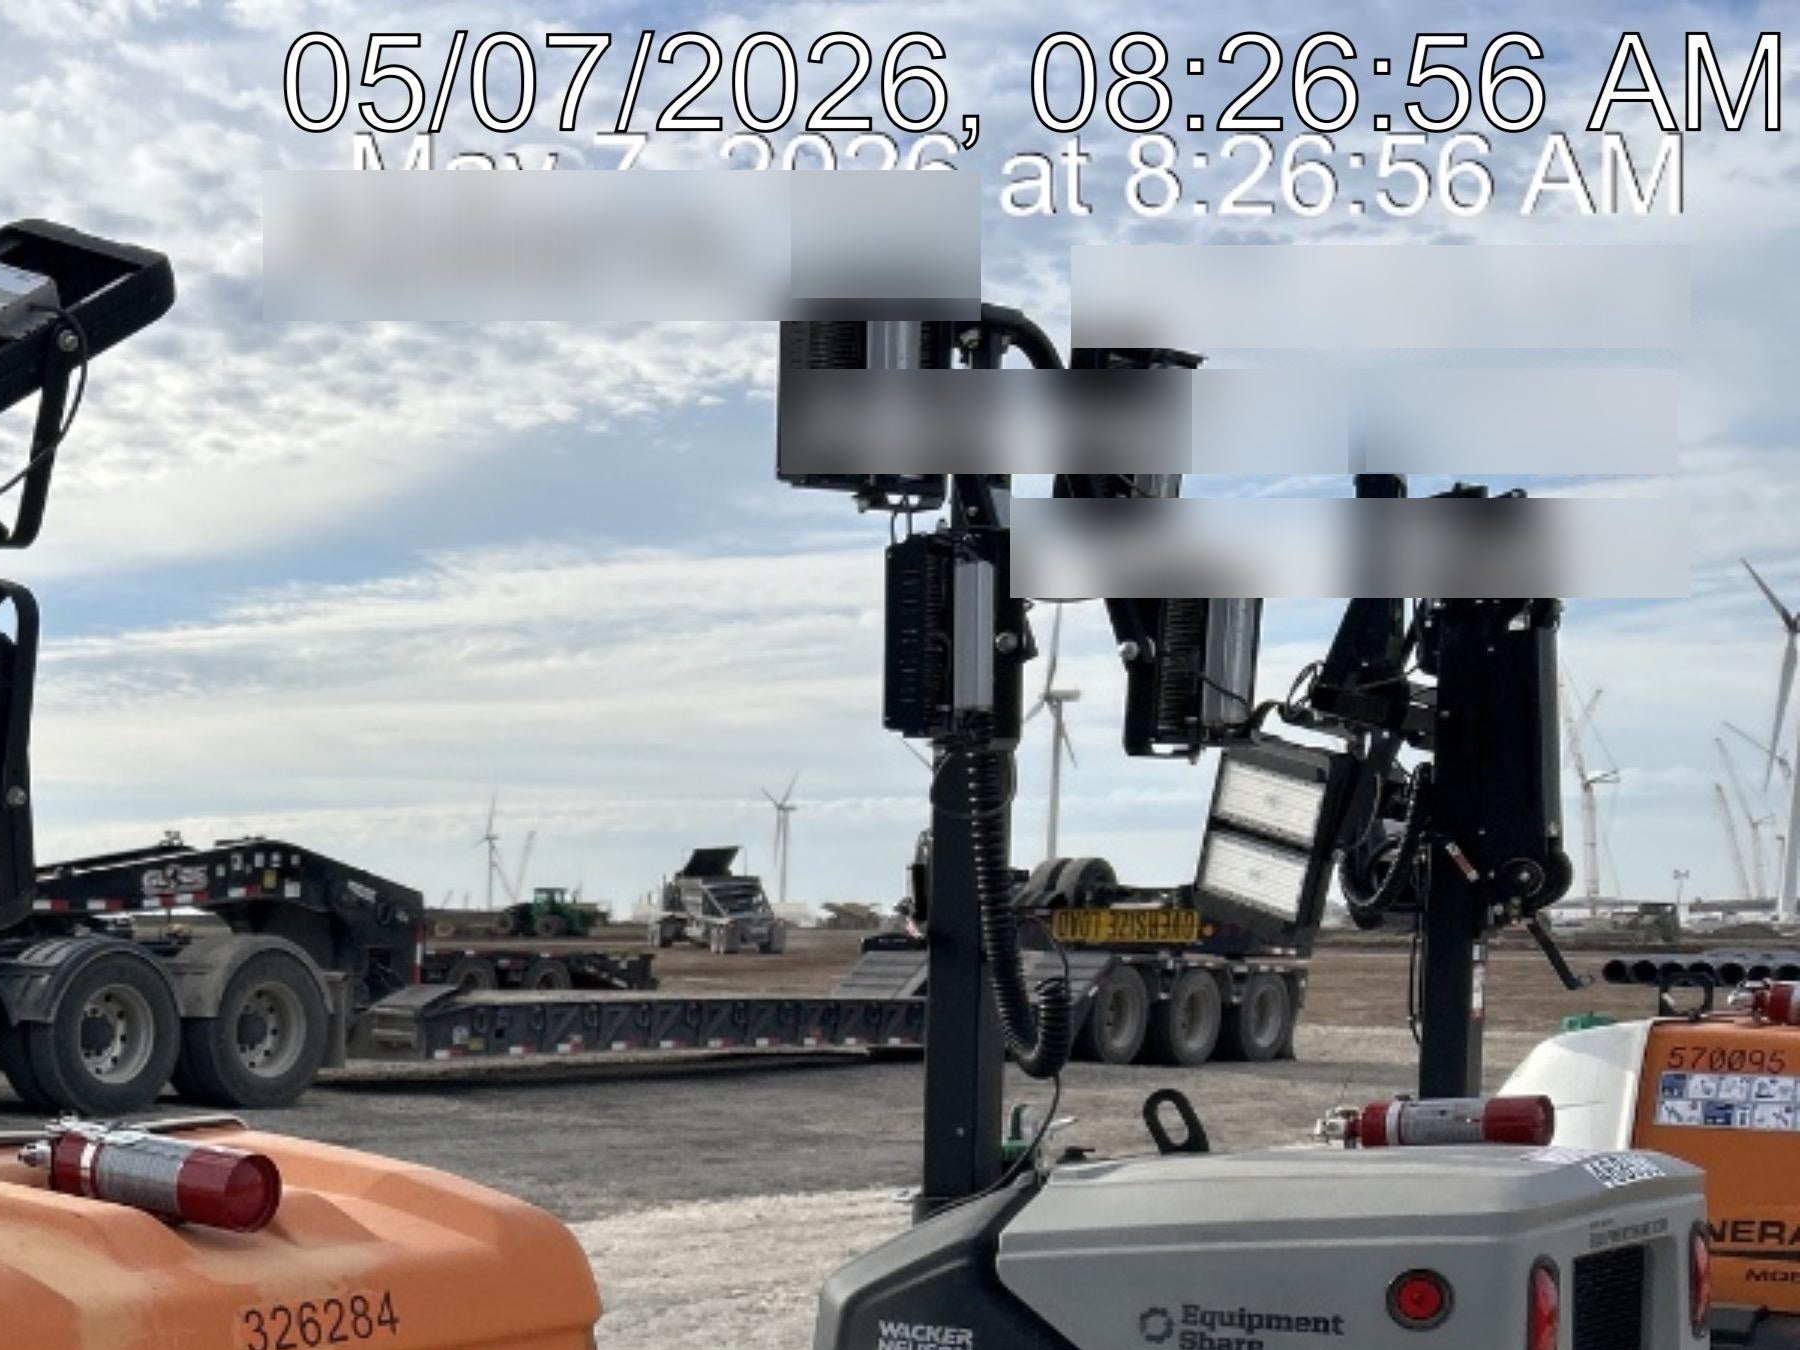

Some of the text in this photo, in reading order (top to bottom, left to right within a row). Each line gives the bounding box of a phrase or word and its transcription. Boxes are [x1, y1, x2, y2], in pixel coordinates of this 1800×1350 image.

[1666, 1047, 1787, 1074] 570095
[878, 1319, 974, 1345] WACKER
[1181, 1304, 1345, 1336] Equipment
